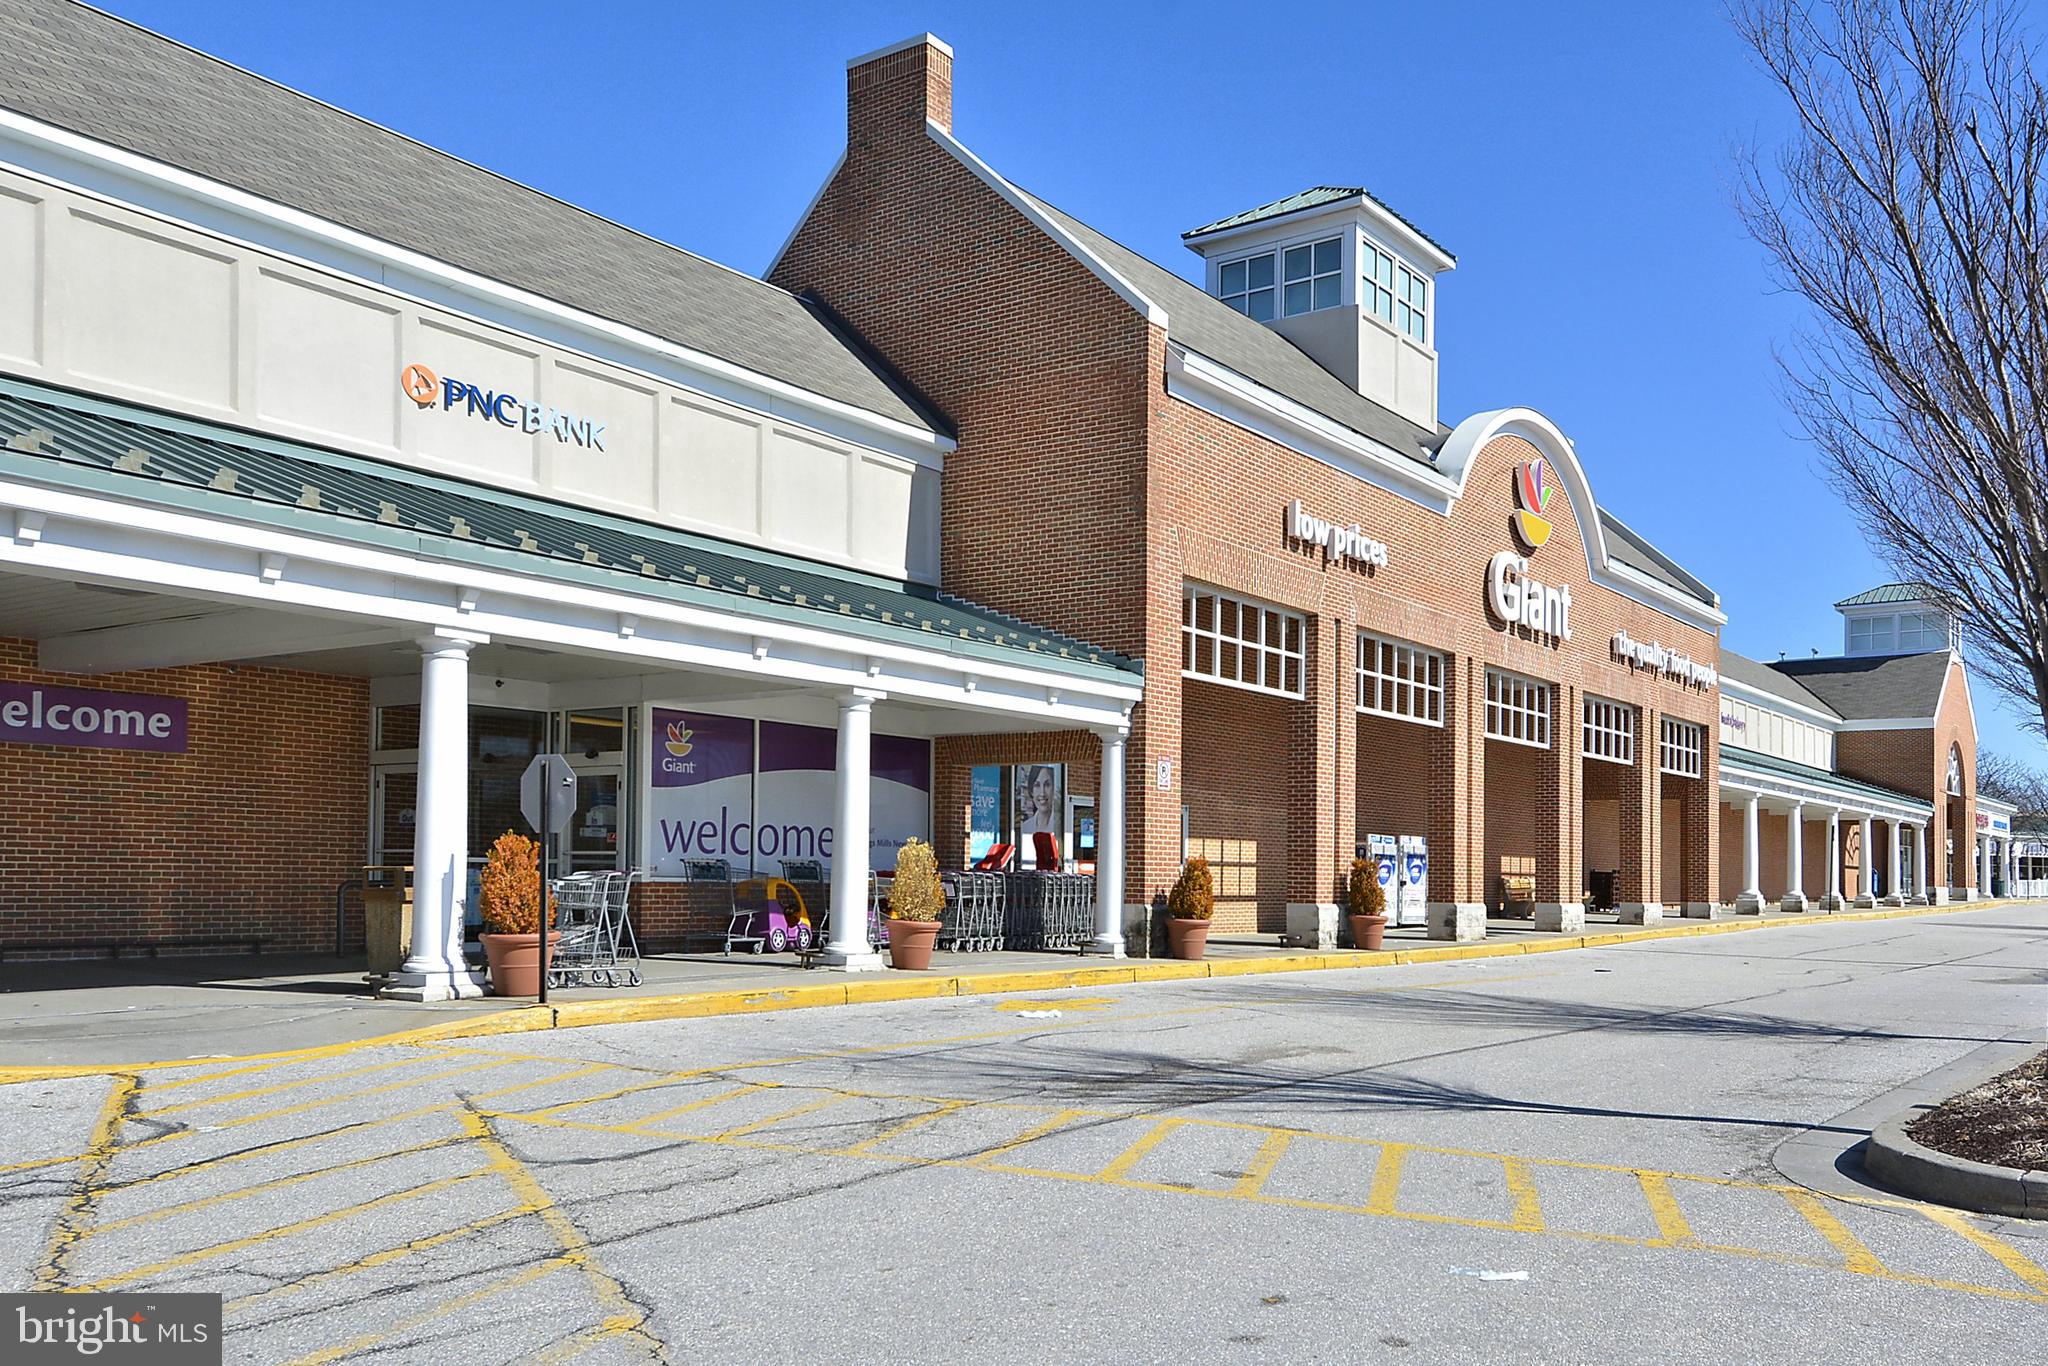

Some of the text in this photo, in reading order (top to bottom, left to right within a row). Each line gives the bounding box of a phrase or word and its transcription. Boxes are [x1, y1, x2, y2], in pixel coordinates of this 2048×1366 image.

[441, 377, 608, 452] PNC BANK
[1289, 499, 1388, 567] low prices
[1489, 550, 1573, 640] Giant
[1614, 630, 1717, 689] the quality food people
[0, 690, 172, 738] elcome
[662, 757, 695, 774] Giant
[660, 806, 833, 858] welcome
